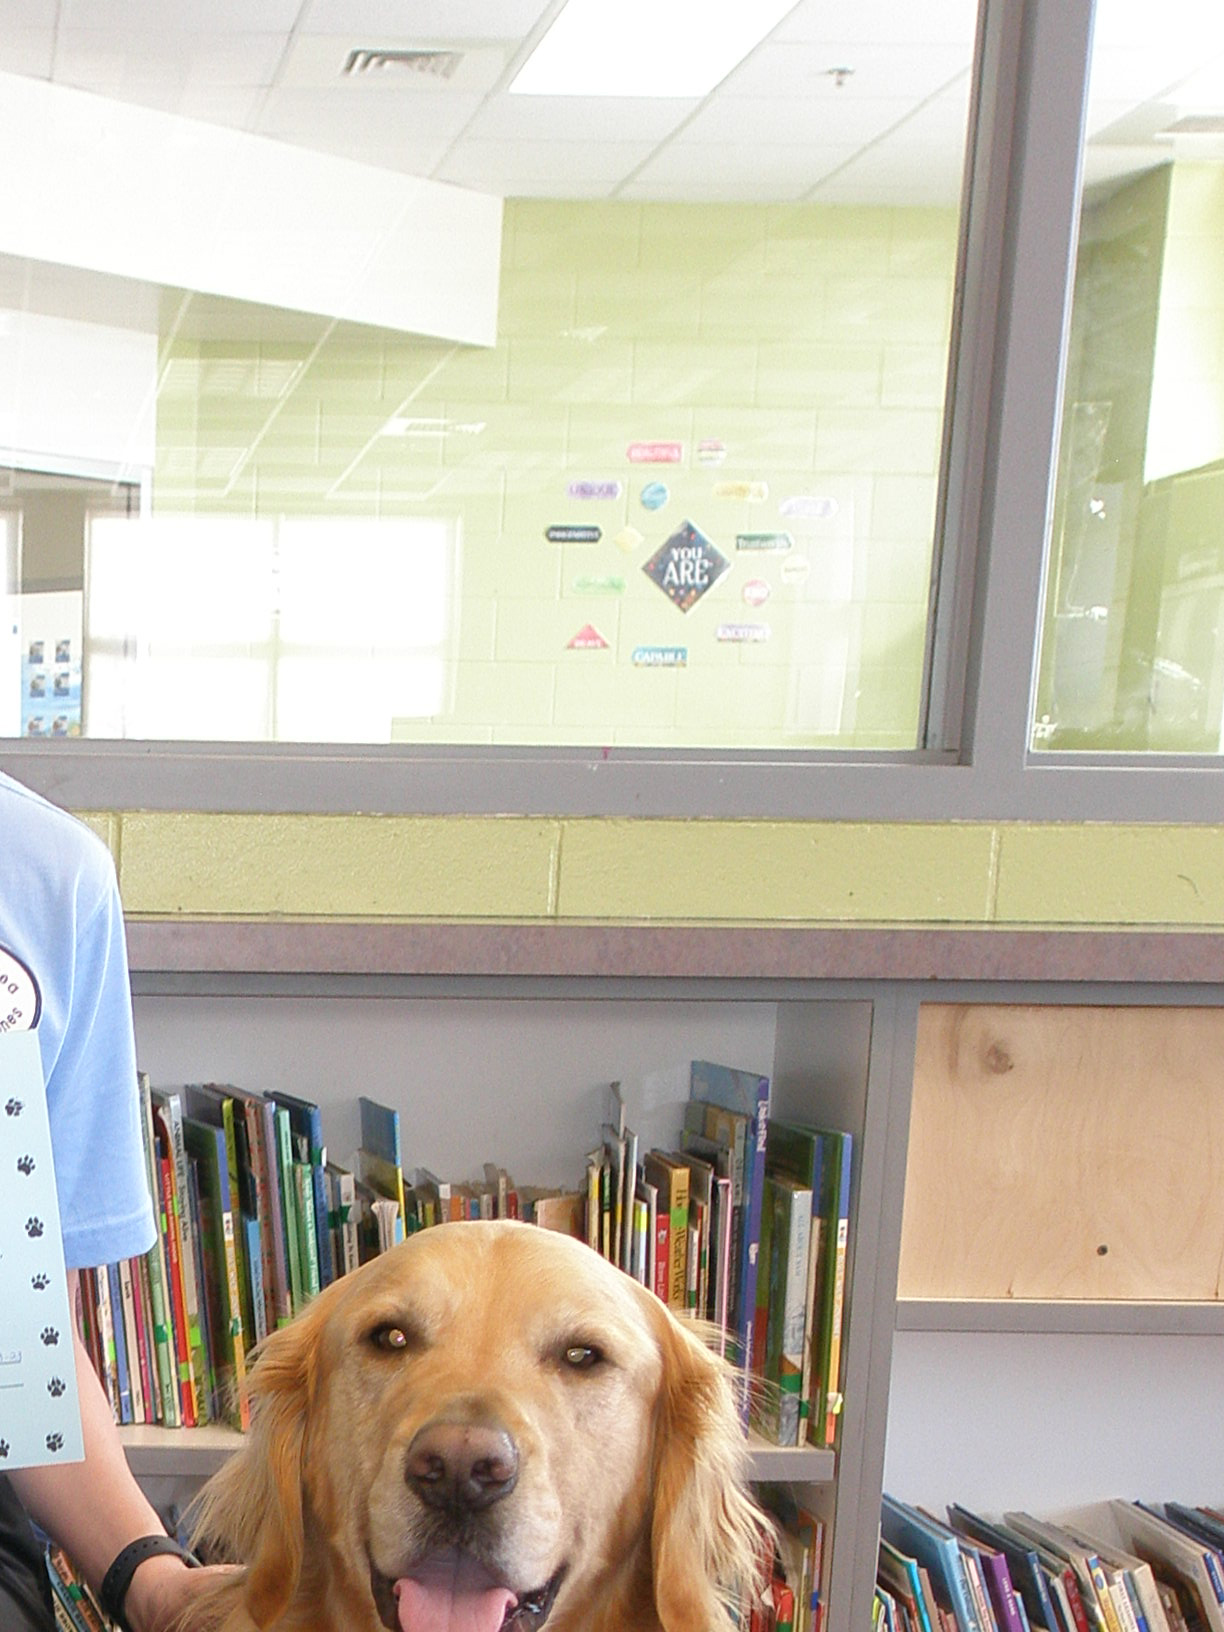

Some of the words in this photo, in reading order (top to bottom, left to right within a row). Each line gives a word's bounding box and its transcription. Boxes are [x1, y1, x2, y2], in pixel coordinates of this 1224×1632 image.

[671, 547, 702, 562] YOU
[662, 559, 711, 586] ARE
[173, 1119, 182, 1157] ANIMAL
